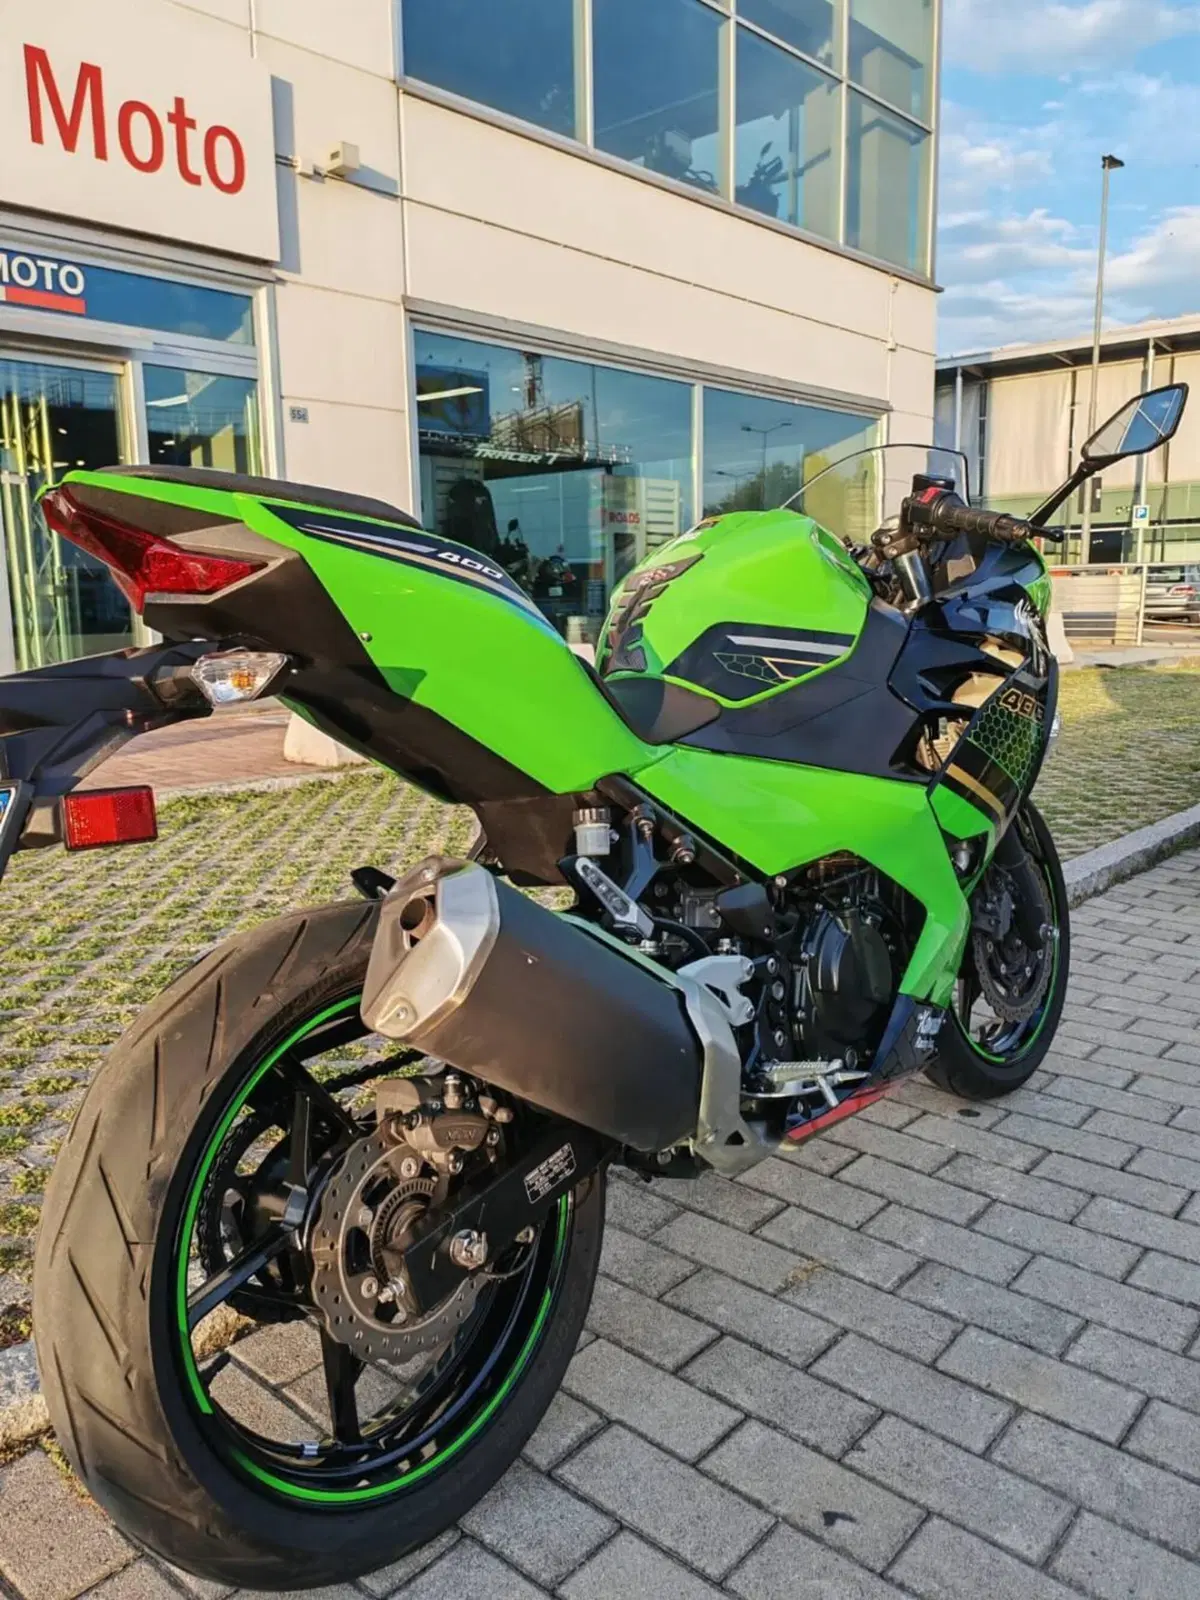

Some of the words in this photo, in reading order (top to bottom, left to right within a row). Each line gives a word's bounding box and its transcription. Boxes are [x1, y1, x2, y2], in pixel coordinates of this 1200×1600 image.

[23, 43, 246, 195] Moto
[474, 448, 542, 464] TRACER
[545, 452, 560, 465] 7
[437, 551, 503, 579] 400
